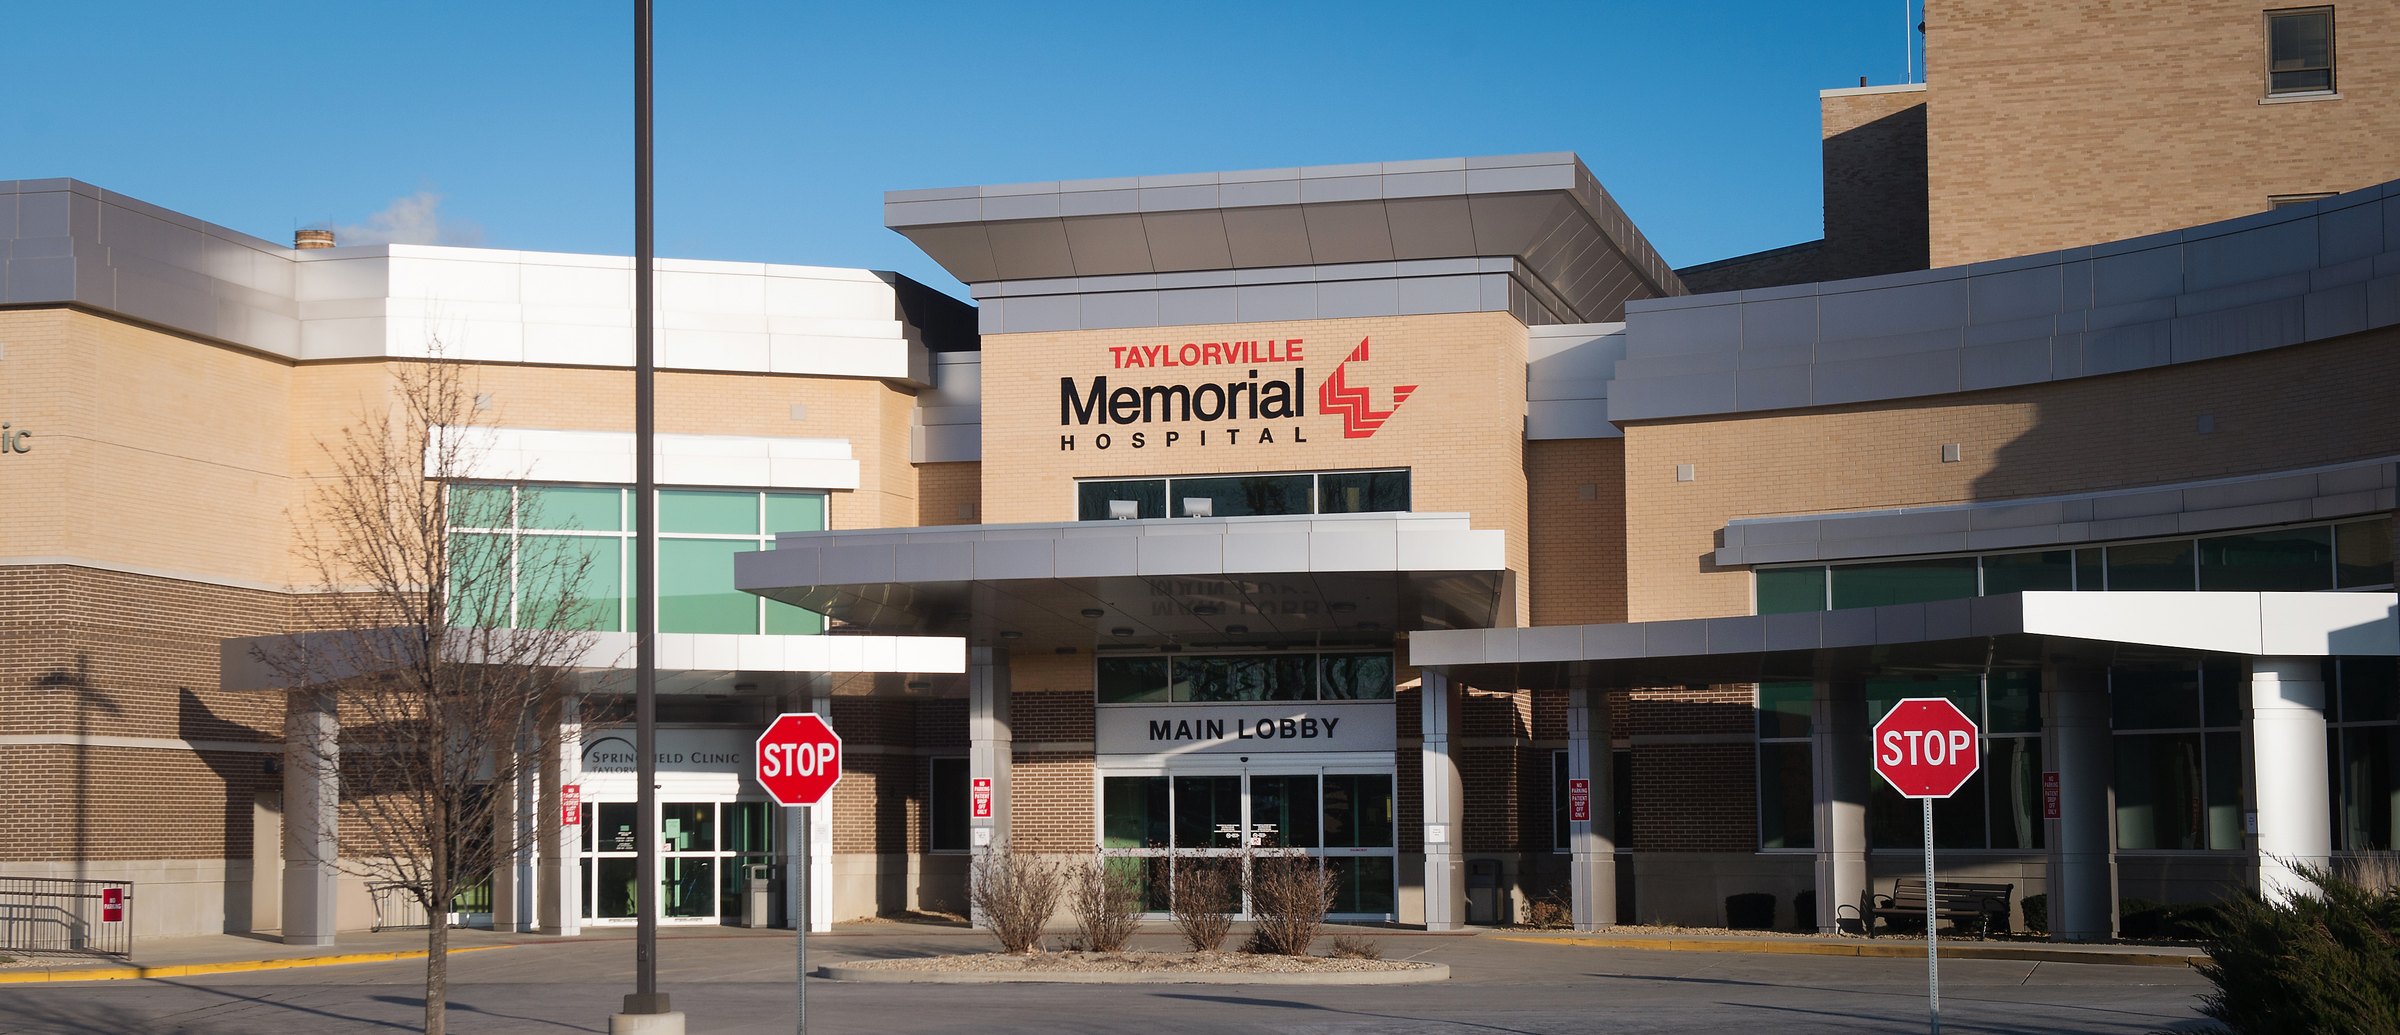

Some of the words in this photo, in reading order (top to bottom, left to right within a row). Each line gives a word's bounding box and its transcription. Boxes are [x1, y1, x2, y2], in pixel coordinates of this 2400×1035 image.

[1109, 339, 1304, 369] TAYLORVILLE
[1061, 368, 1304, 426] Memorial
[1061, 427, 1307, 451] HOSPITAL
[1150, 719, 1224, 741] MAIN
[1238, 717, 1340, 740] LOBBY
[592, 751, 683, 764] SPRINIELD
[763, 742, 836, 777] STOP
[1882, 730, 1970, 766] STOP
